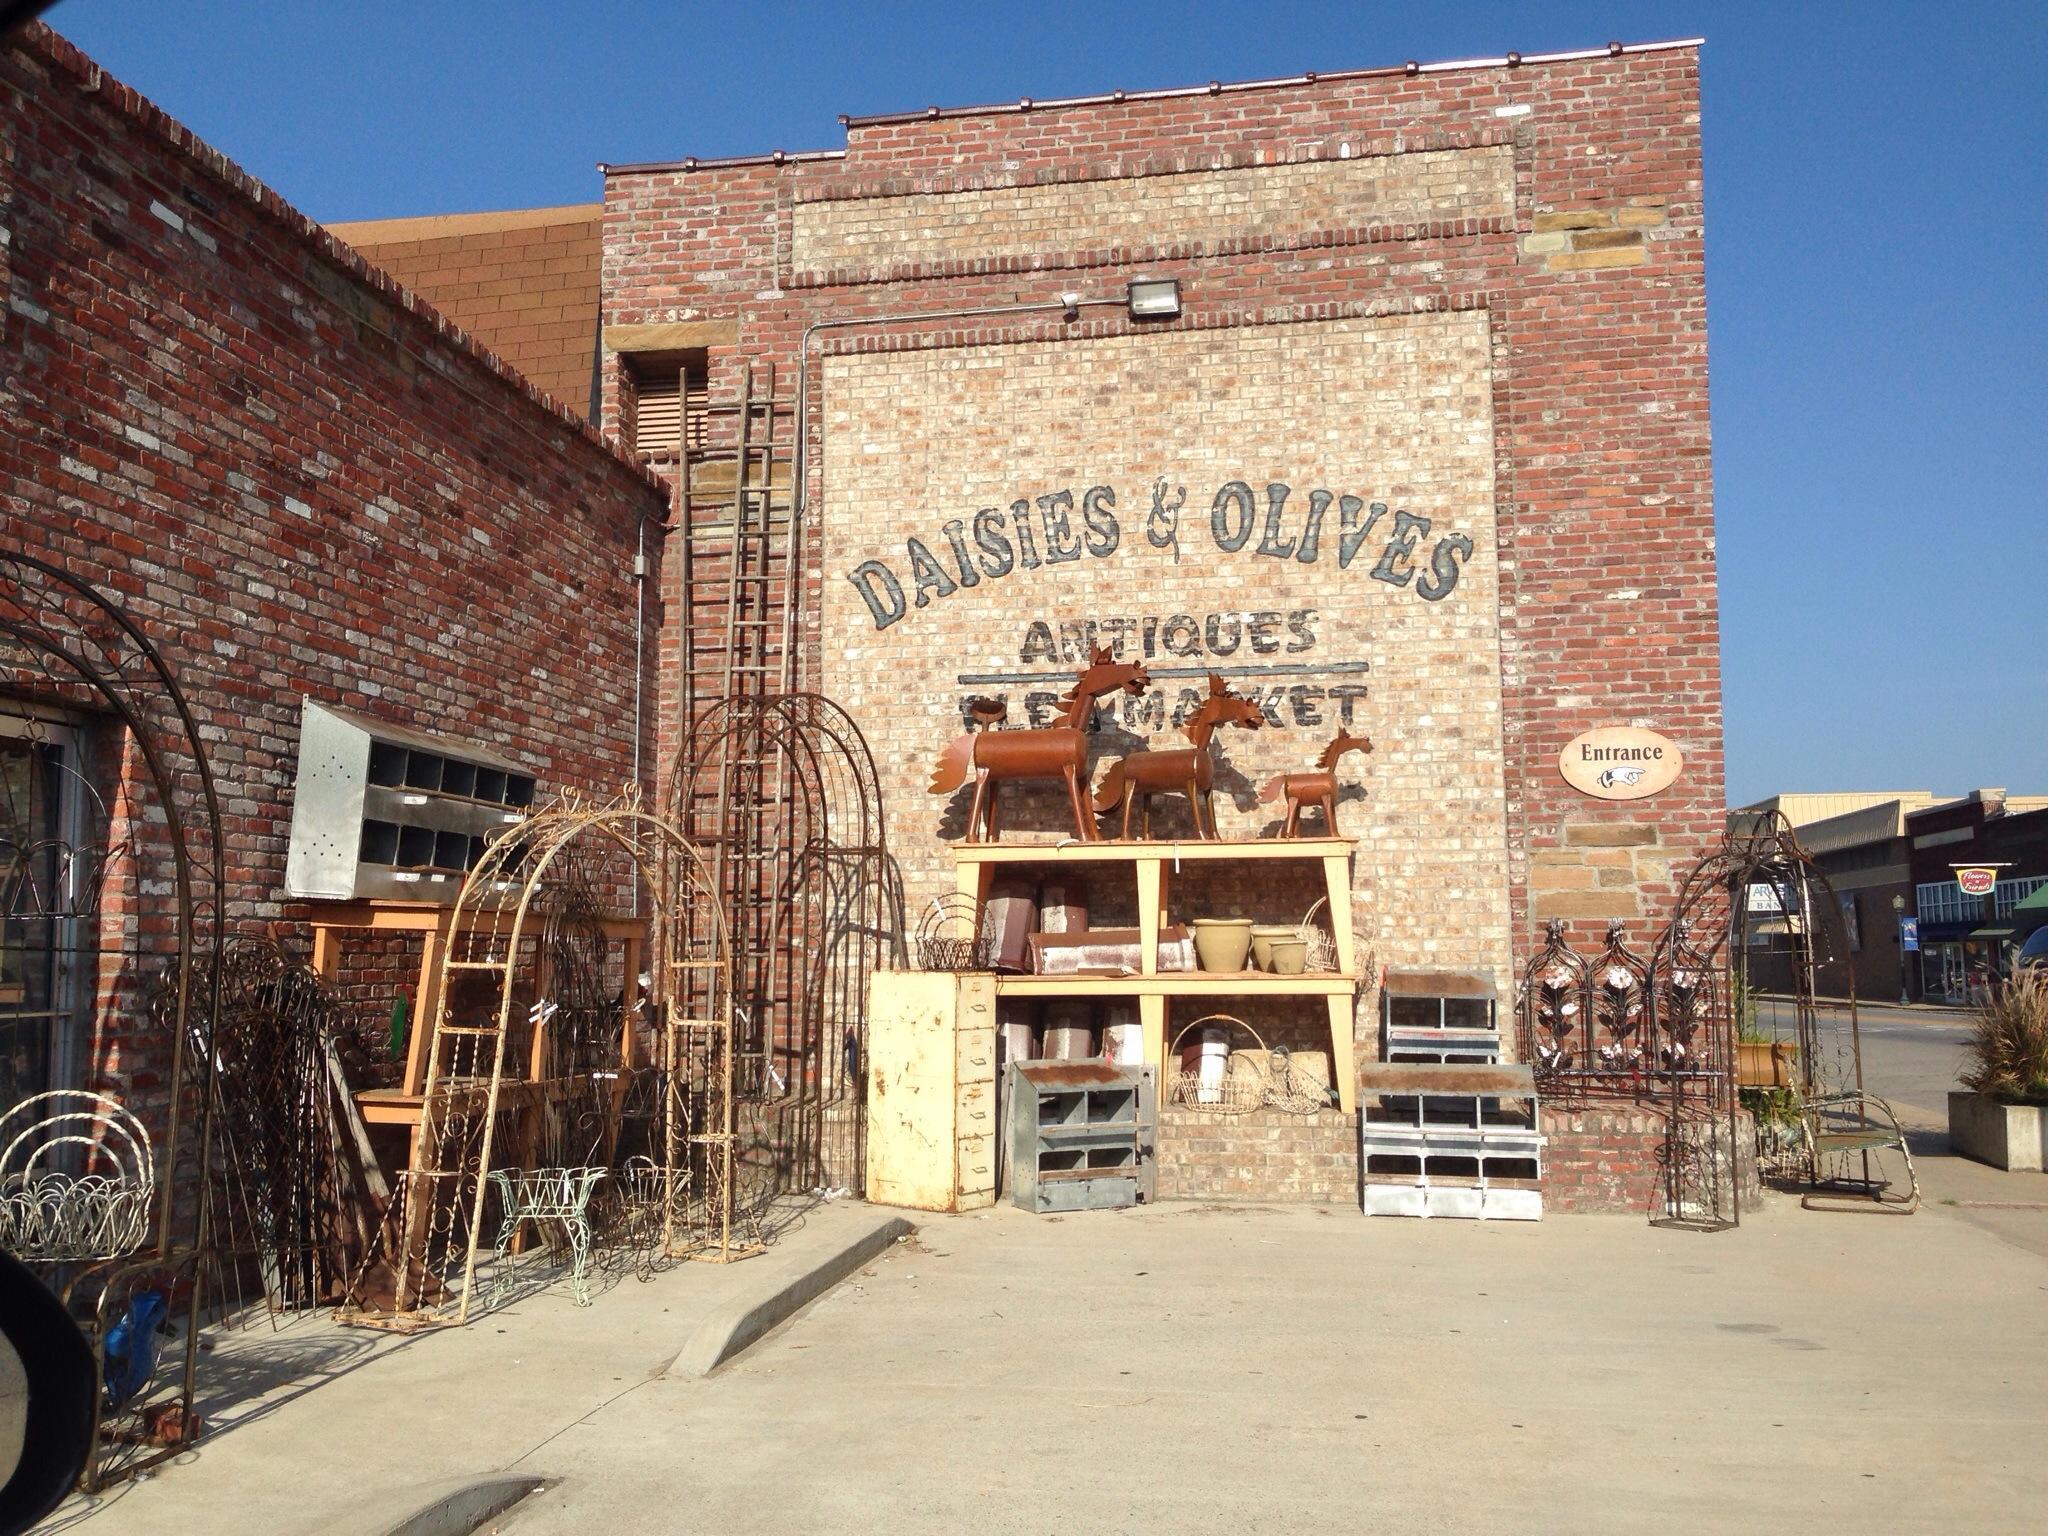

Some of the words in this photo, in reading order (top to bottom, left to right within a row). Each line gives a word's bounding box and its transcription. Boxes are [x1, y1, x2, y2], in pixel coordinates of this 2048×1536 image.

[848, 486, 1120, 631] DAISIES
[1147, 476, 1186, 564] &
[1210, 480, 1474, 601] OLIVES
[1020, 609, 1319, 663] ANTIQUES
[1123, 685, 1368, 731] MAKET
[1581, 743, 1663, 761] Entrance
